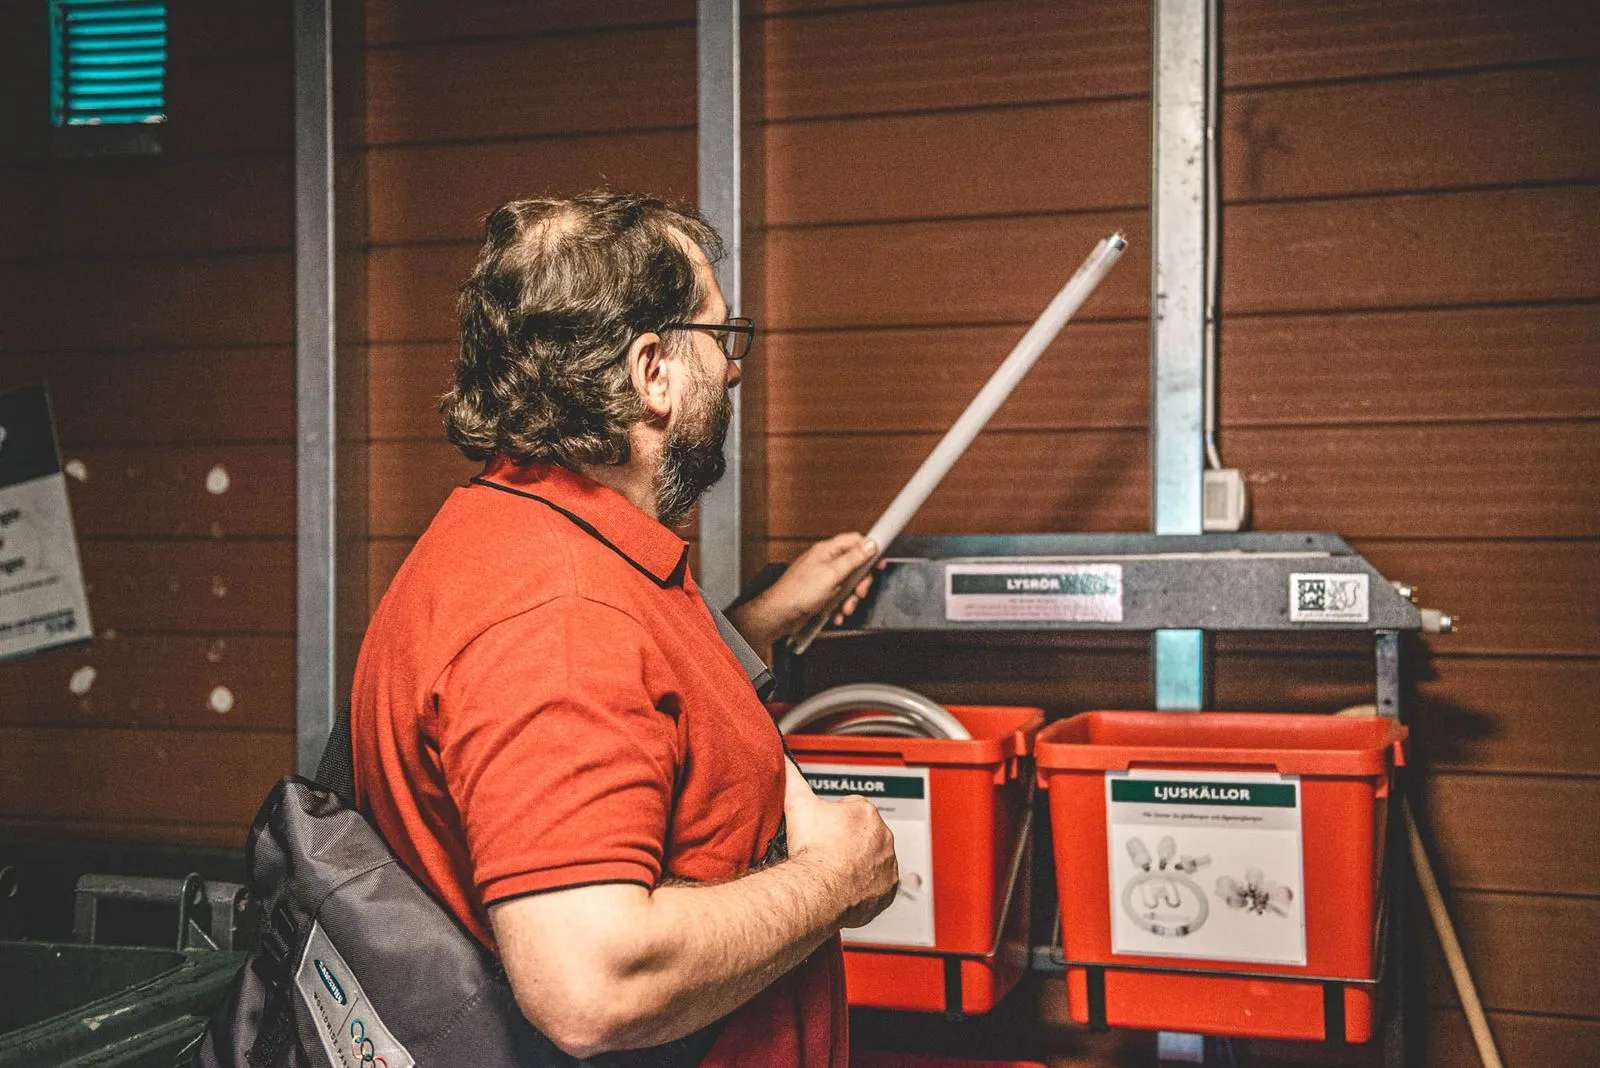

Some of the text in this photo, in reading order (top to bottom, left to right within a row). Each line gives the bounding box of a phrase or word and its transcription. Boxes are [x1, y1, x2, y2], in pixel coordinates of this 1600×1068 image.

[1007, 577, 1060, 590] LYSRÖR
[809, 778, 885, 792] USKÄLLOR
[1154, 786, 1251, 800] LJUSKÄLLOR
[314, 991, 338, 1047] WORLDWIDE
